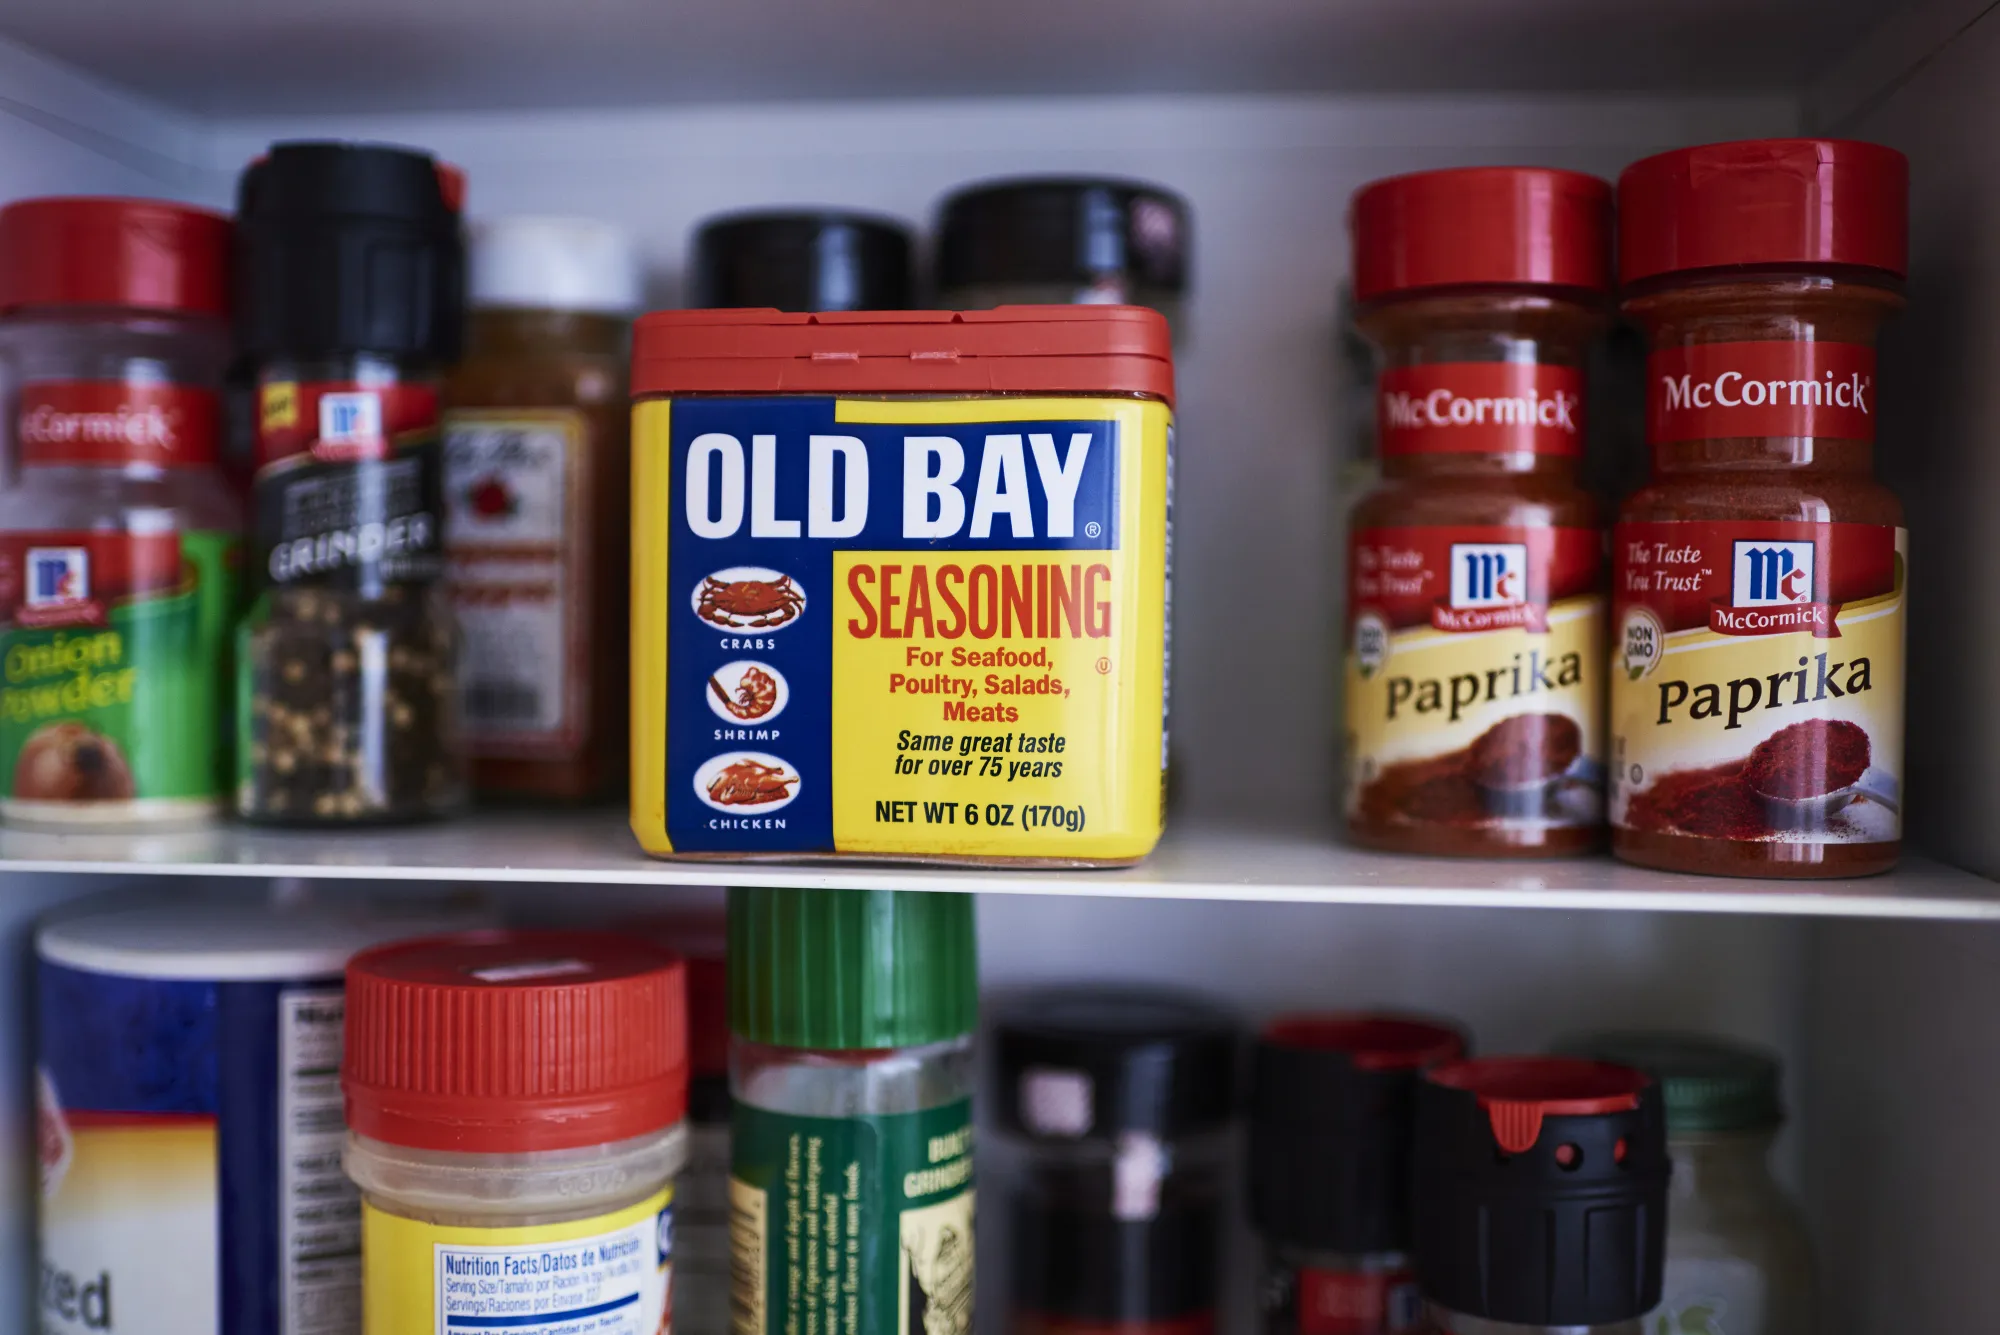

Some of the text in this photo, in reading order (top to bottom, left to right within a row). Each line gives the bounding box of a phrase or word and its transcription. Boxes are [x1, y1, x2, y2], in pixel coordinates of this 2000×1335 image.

[1664, 372, 1868, 414] McCormick
[1387, 389, 1576, 433] McCormick
[685, 432, 870, 540] OLD
[1627, 541, 1701, 564] The Taste
[1626, 570, 1649, 591] You
[847, 564, 1112, 640] SEASONING
[1716, 607, 1824, 630] McCormick
[720, 638, 776, 650] CRABS
[1627, 626, 1652, 640] NON
[5, 631, 122, 683] Onion
[906, 647, 1054, 671] For Seafood,
[1627, 643, 1653, 657] GMO
[0, 668, 137, 722] owder
[889, 674, 1071, 698] Poultry, Salads,
[1385, 647, 1583, 721] Paprika
[1657, 653, 1873, 731] Paprika
[943, 703, 1019, 723] Meats
[713, 729, 782, 741] SHRIMP
[896, 730, 1066, 757] Same great taste
[895, 755, 1062, 782] for over 75 years
[709, 818, 787, 830] CHICKEN
[875, 801, 1086, 832] NET WT 6 OZ (170g)
[803, 1212, 819, 1238] and
[445, 1254, 500, 1277] Nutrition
[504, 1251, 577, 1276] Facts/Datos
[581, 1250, 595, 1267] de
[445, 1277, 477, 1297] Serving
[536, 1279, 550, 1295] por
[445, 1296, 531, 1319] Servings/Raciones
[534, 1295, 549, 1312] por
